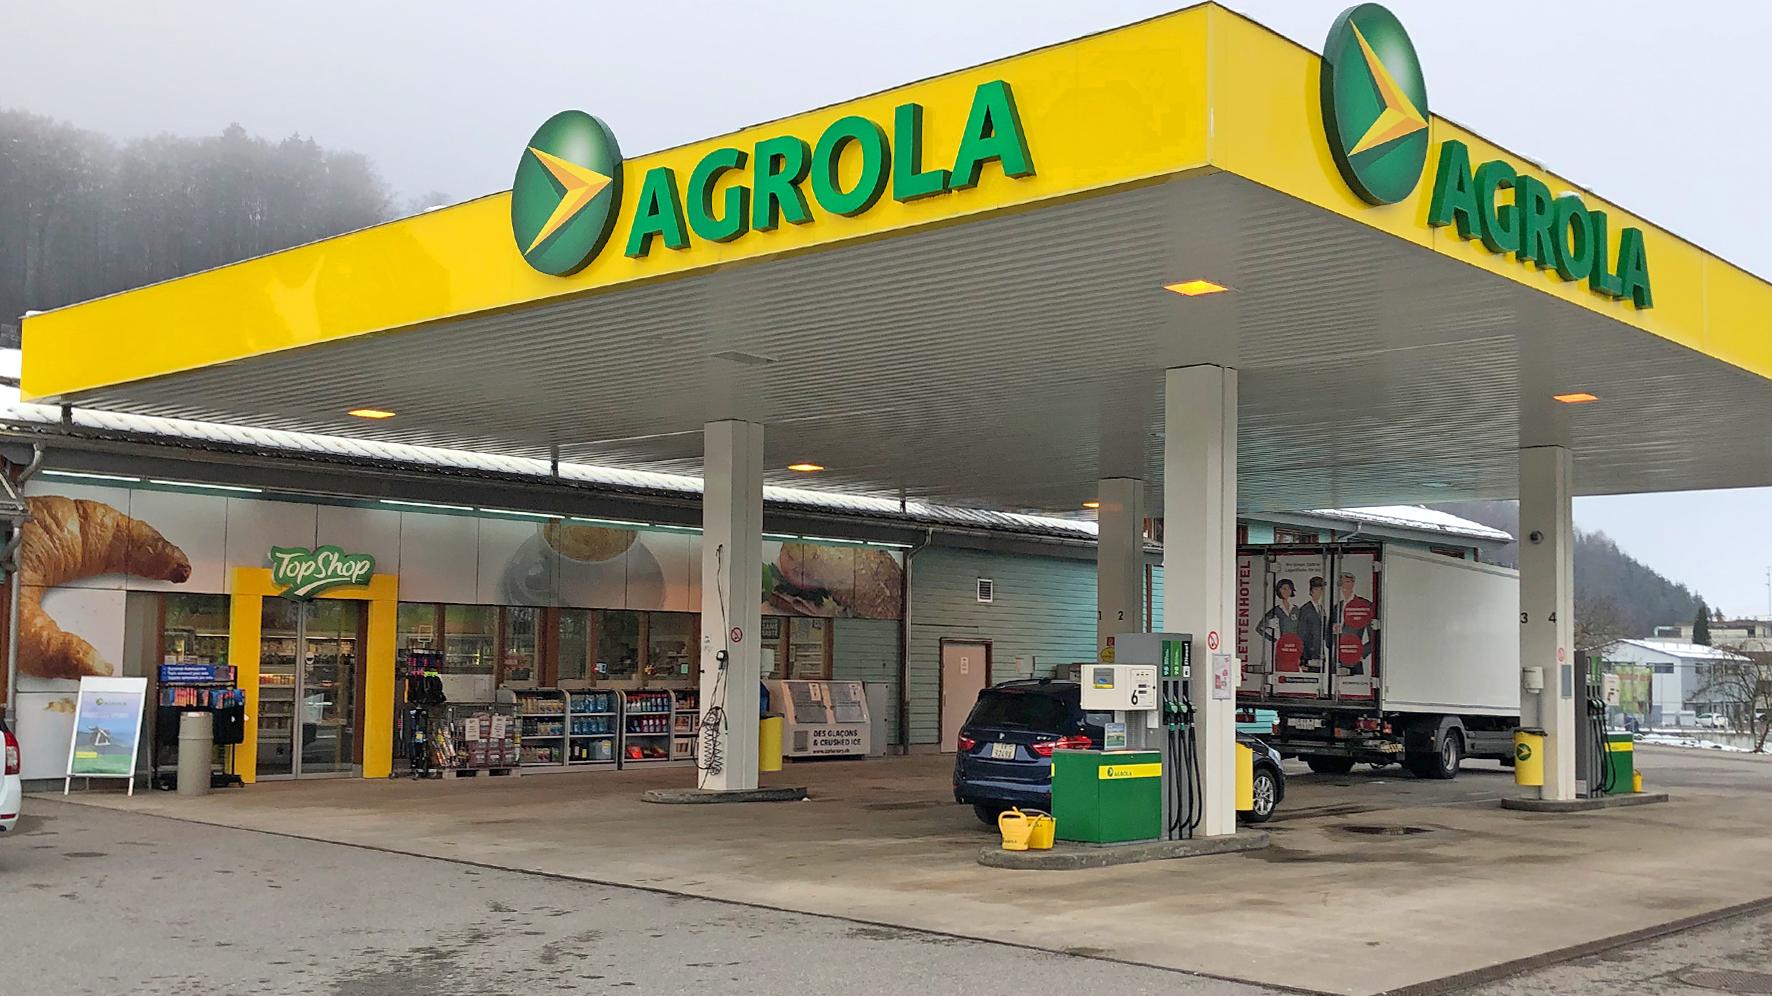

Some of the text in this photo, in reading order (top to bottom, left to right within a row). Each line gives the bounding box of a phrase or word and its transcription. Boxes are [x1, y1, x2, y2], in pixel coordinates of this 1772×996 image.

[624, 80, 1036, 258] AGROLA
[1427, 139, 1654, 310] AGROLA
[1118, 610, 1124, 621] 2
[1520, 612, 1529, 624] 3
[1548, 612, 1557, 624] 4
[1131, 689, 1139, 705] 6
[828, 730, 858, 738] GLAÇONS
[851, 738, 862, 746] ICE
